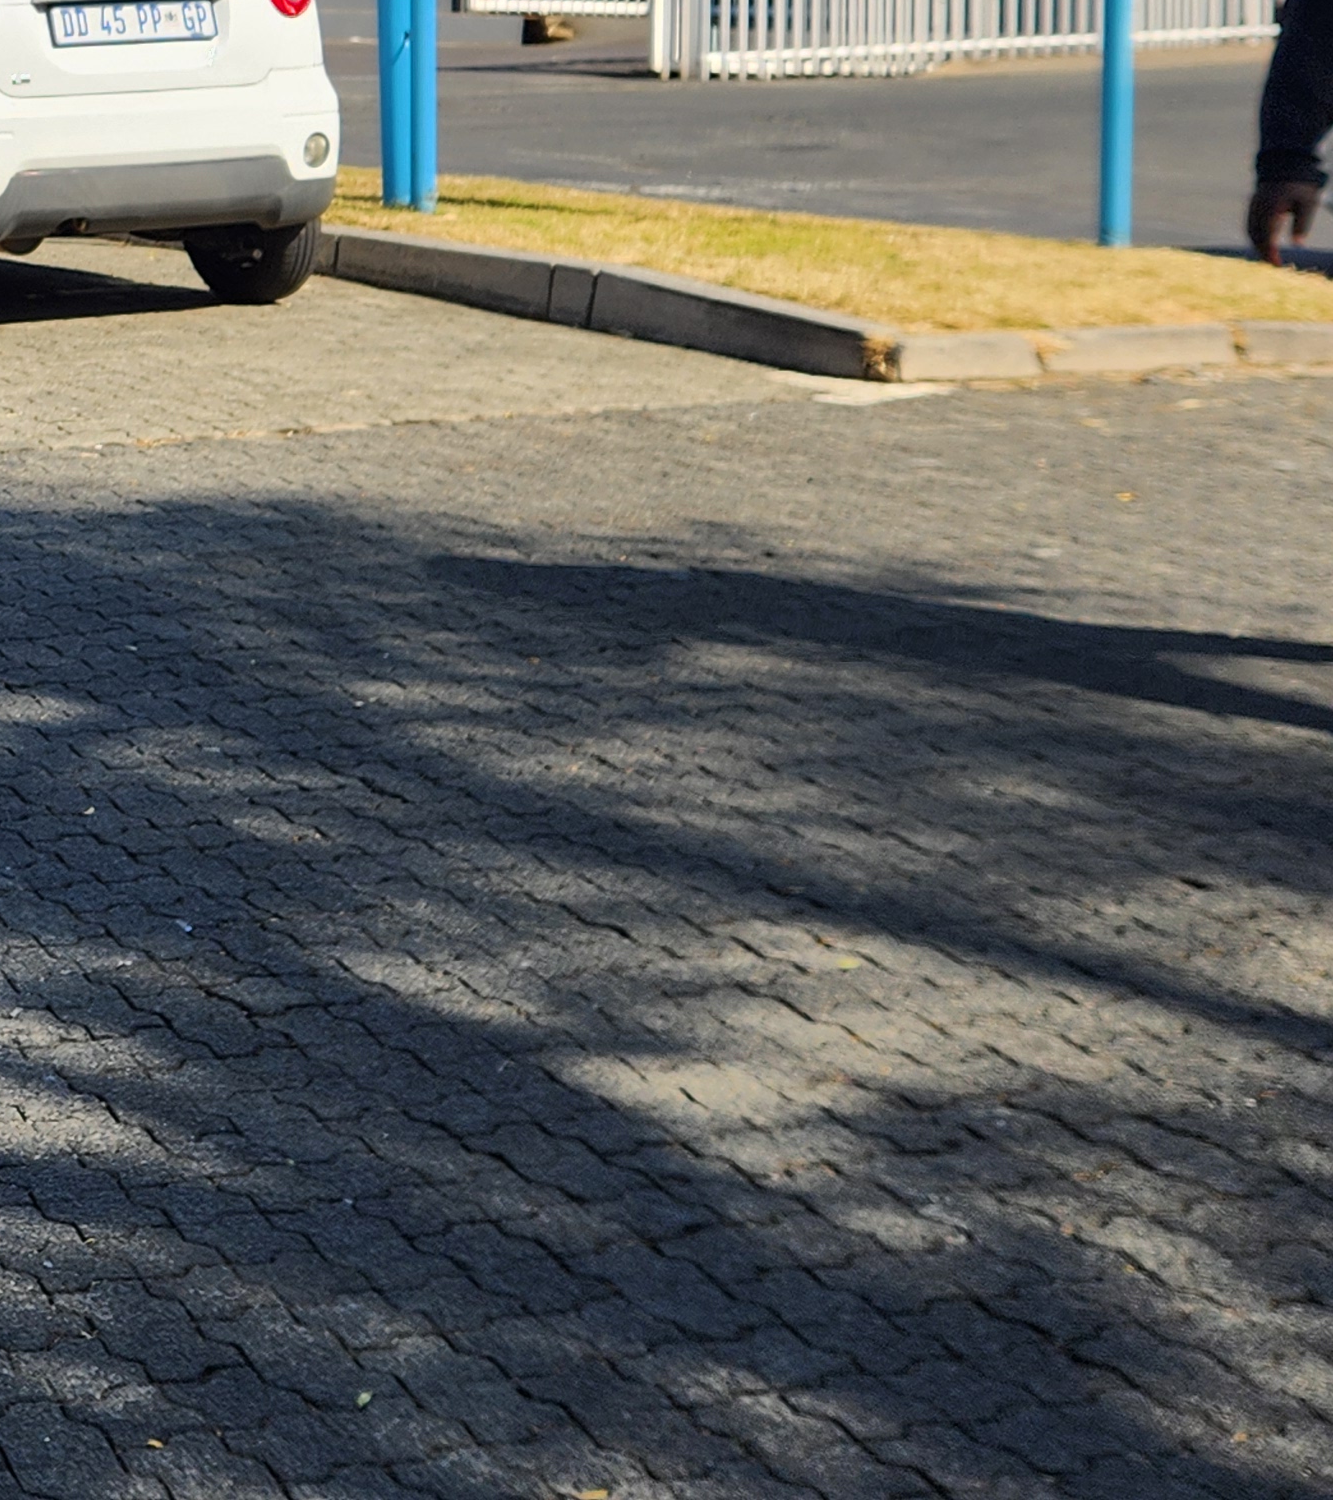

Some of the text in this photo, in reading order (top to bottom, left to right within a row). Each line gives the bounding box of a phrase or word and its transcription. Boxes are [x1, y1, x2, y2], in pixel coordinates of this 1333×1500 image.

[60, 1, 208, 38] DD 45 PP GP
